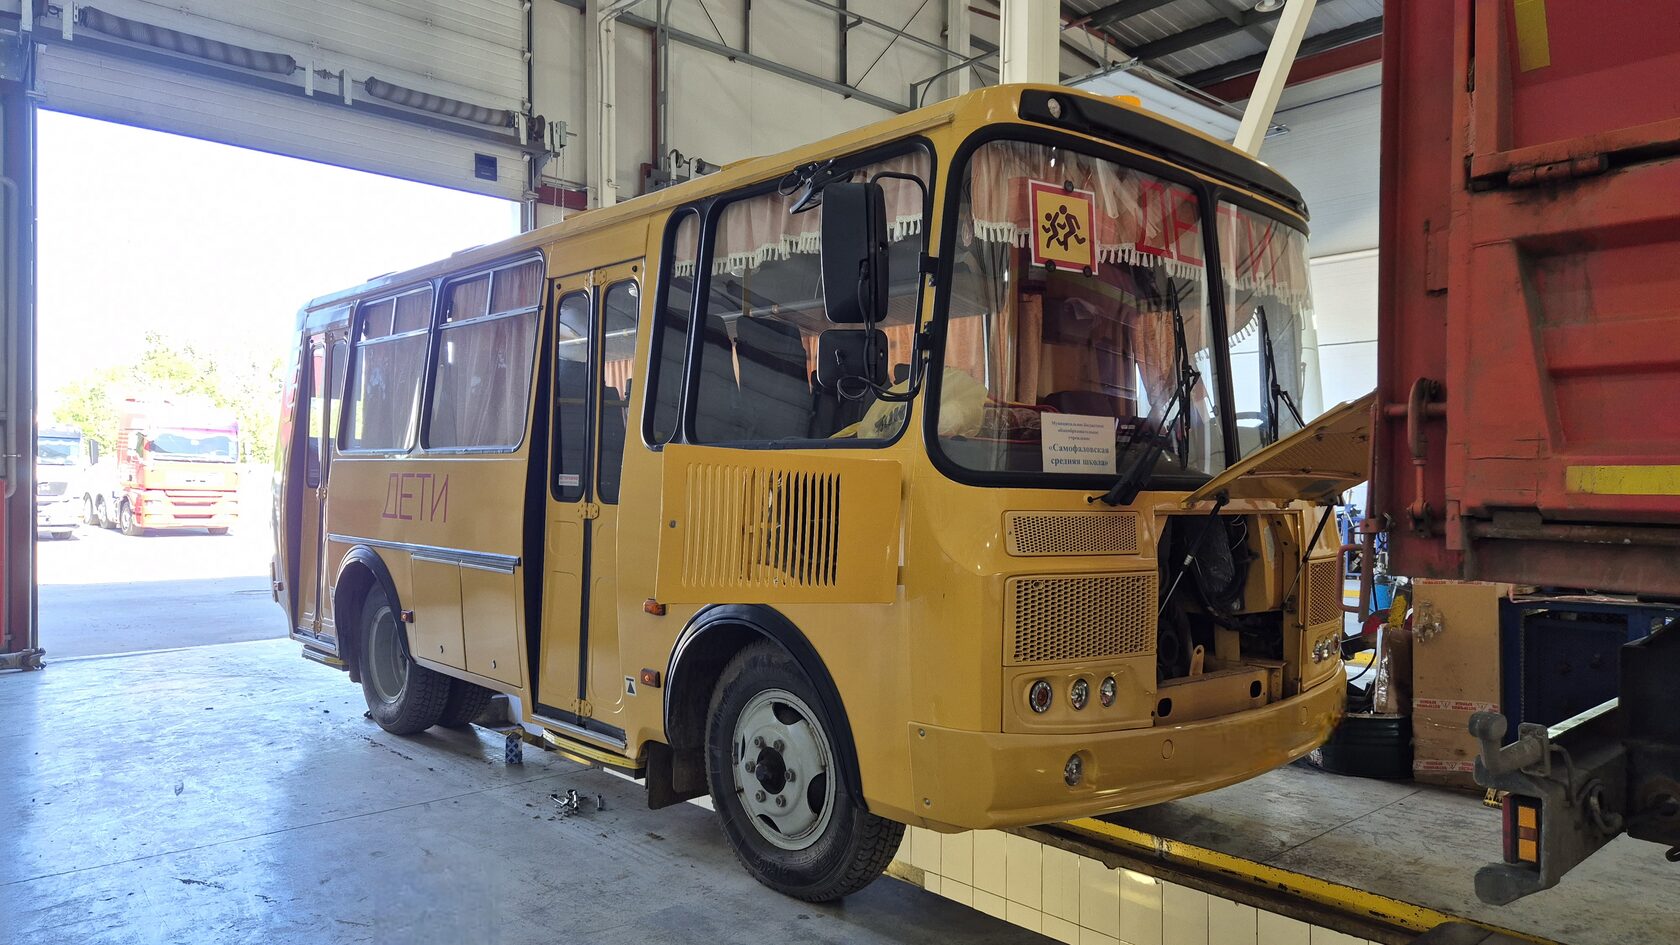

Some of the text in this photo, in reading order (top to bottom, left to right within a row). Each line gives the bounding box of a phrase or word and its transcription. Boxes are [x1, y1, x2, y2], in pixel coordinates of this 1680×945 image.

[1135, 180, 1277, 288] ДЕТИ
[1049, 443, 1109, 454] «Самофаловская
[1051, 458, 1080, 467] средняя
[382, 473, 448, 523] ДЕТИ
